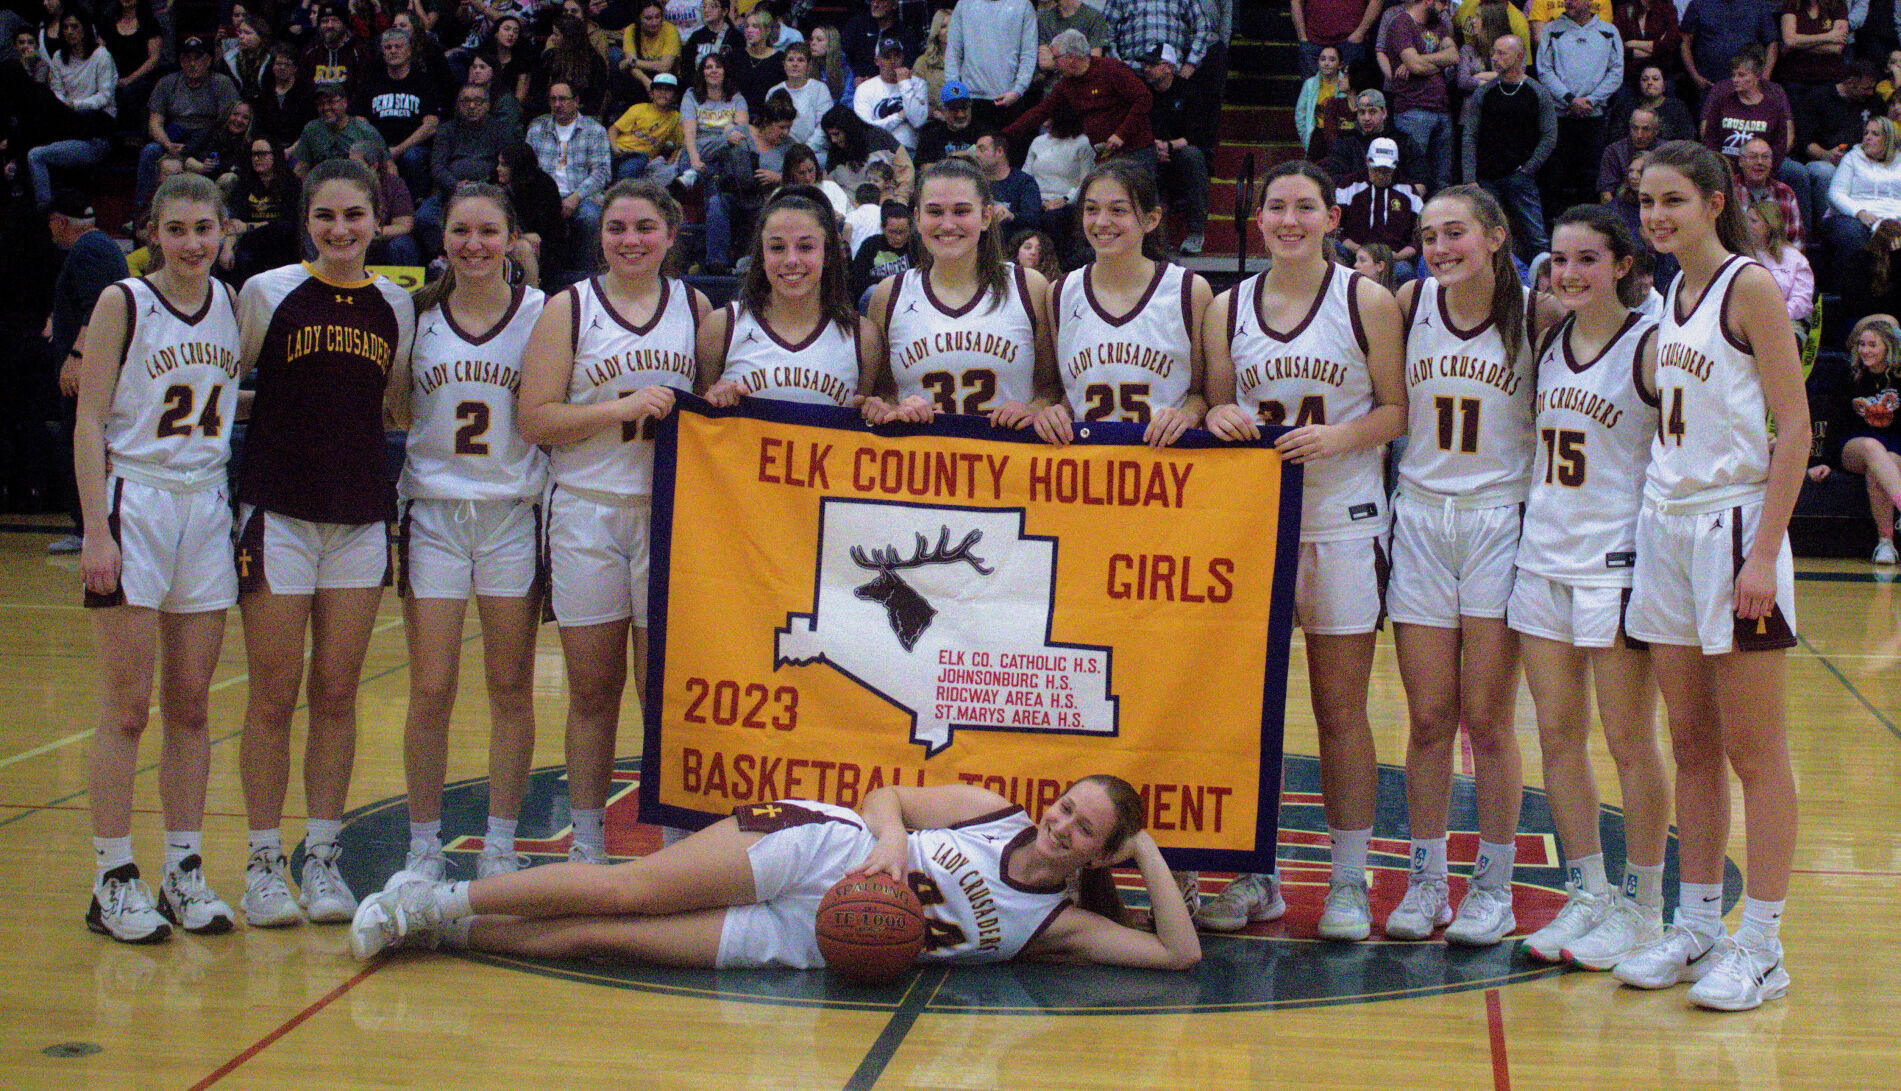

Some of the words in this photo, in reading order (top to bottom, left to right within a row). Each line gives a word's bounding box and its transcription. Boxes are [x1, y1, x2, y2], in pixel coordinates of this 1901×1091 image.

[372, 93, 395, 114] PENN
[395, 93, 420, 114] STATE
[1722, 117, 1767, 132] CRUSADER
[145, 346, 178, 379] LADY
[287, 325, 321, 362] LADY
[899, 337, 930, 369] LADY
[934, 330, 1019, 365] CRUSADERS
[1067, 347, 1093, 380] LADY
[1098, 342, 1174, 378] CRUSADERS
[418, 362, 448, 395] LADY
[585, 355, 622, 387] LADY
[626, 349, 695, 382] CRUSADERS
[741, 368, 768, 393] ADY
[774, 366, 849, 406] CRUSADERS
[1265, 356, 1348, 387] CRUSADERS
[1408, 357, 1433, 387] LADY
[1440, 355, 1522, 396] CRUSADERS
[921, 367, 998, 416] 32
[1084, 382, 1152, 424] 25
[1550, 387, 1623, 428] CRUSADERS
[156, 384, 224, 439] 24
[454, 399, 492, 456] 2
[1434, 395, 1481, 454] 11
[759, 437, 833, 489] ELK
[853, 447, 1010, 500] COUNTY
[1030, 457, 1193, 508] HOLIDAY
[1542, 428, 1586, 489] 15
[1107, 554, 1234, 603] GIRLS
[938, 668, 1038, 688] JOHNSONBURG
[1046, 675, 1073, 690] H.S.
[939, 649, 965, 666] ELK
[972, 652, 993, 668] CO.
[1000, 653, 1067, 671] CATHOLIC
[1073, 658, 1101, 674] H.S.
[684, 677, 799, 731] 2023
[936, 686, 999, 704] RIDGWAY
[1005, 691, 1043, 707] AREA
[1050, 694, 1078, 709] H.S.
[1012, 709, 1050, 726] AREA
[1058, 712, 1085, 728] H.S.
[931, 842, 970, 875] LADY
[959, 870, 1001, 951] CRUSADERS
